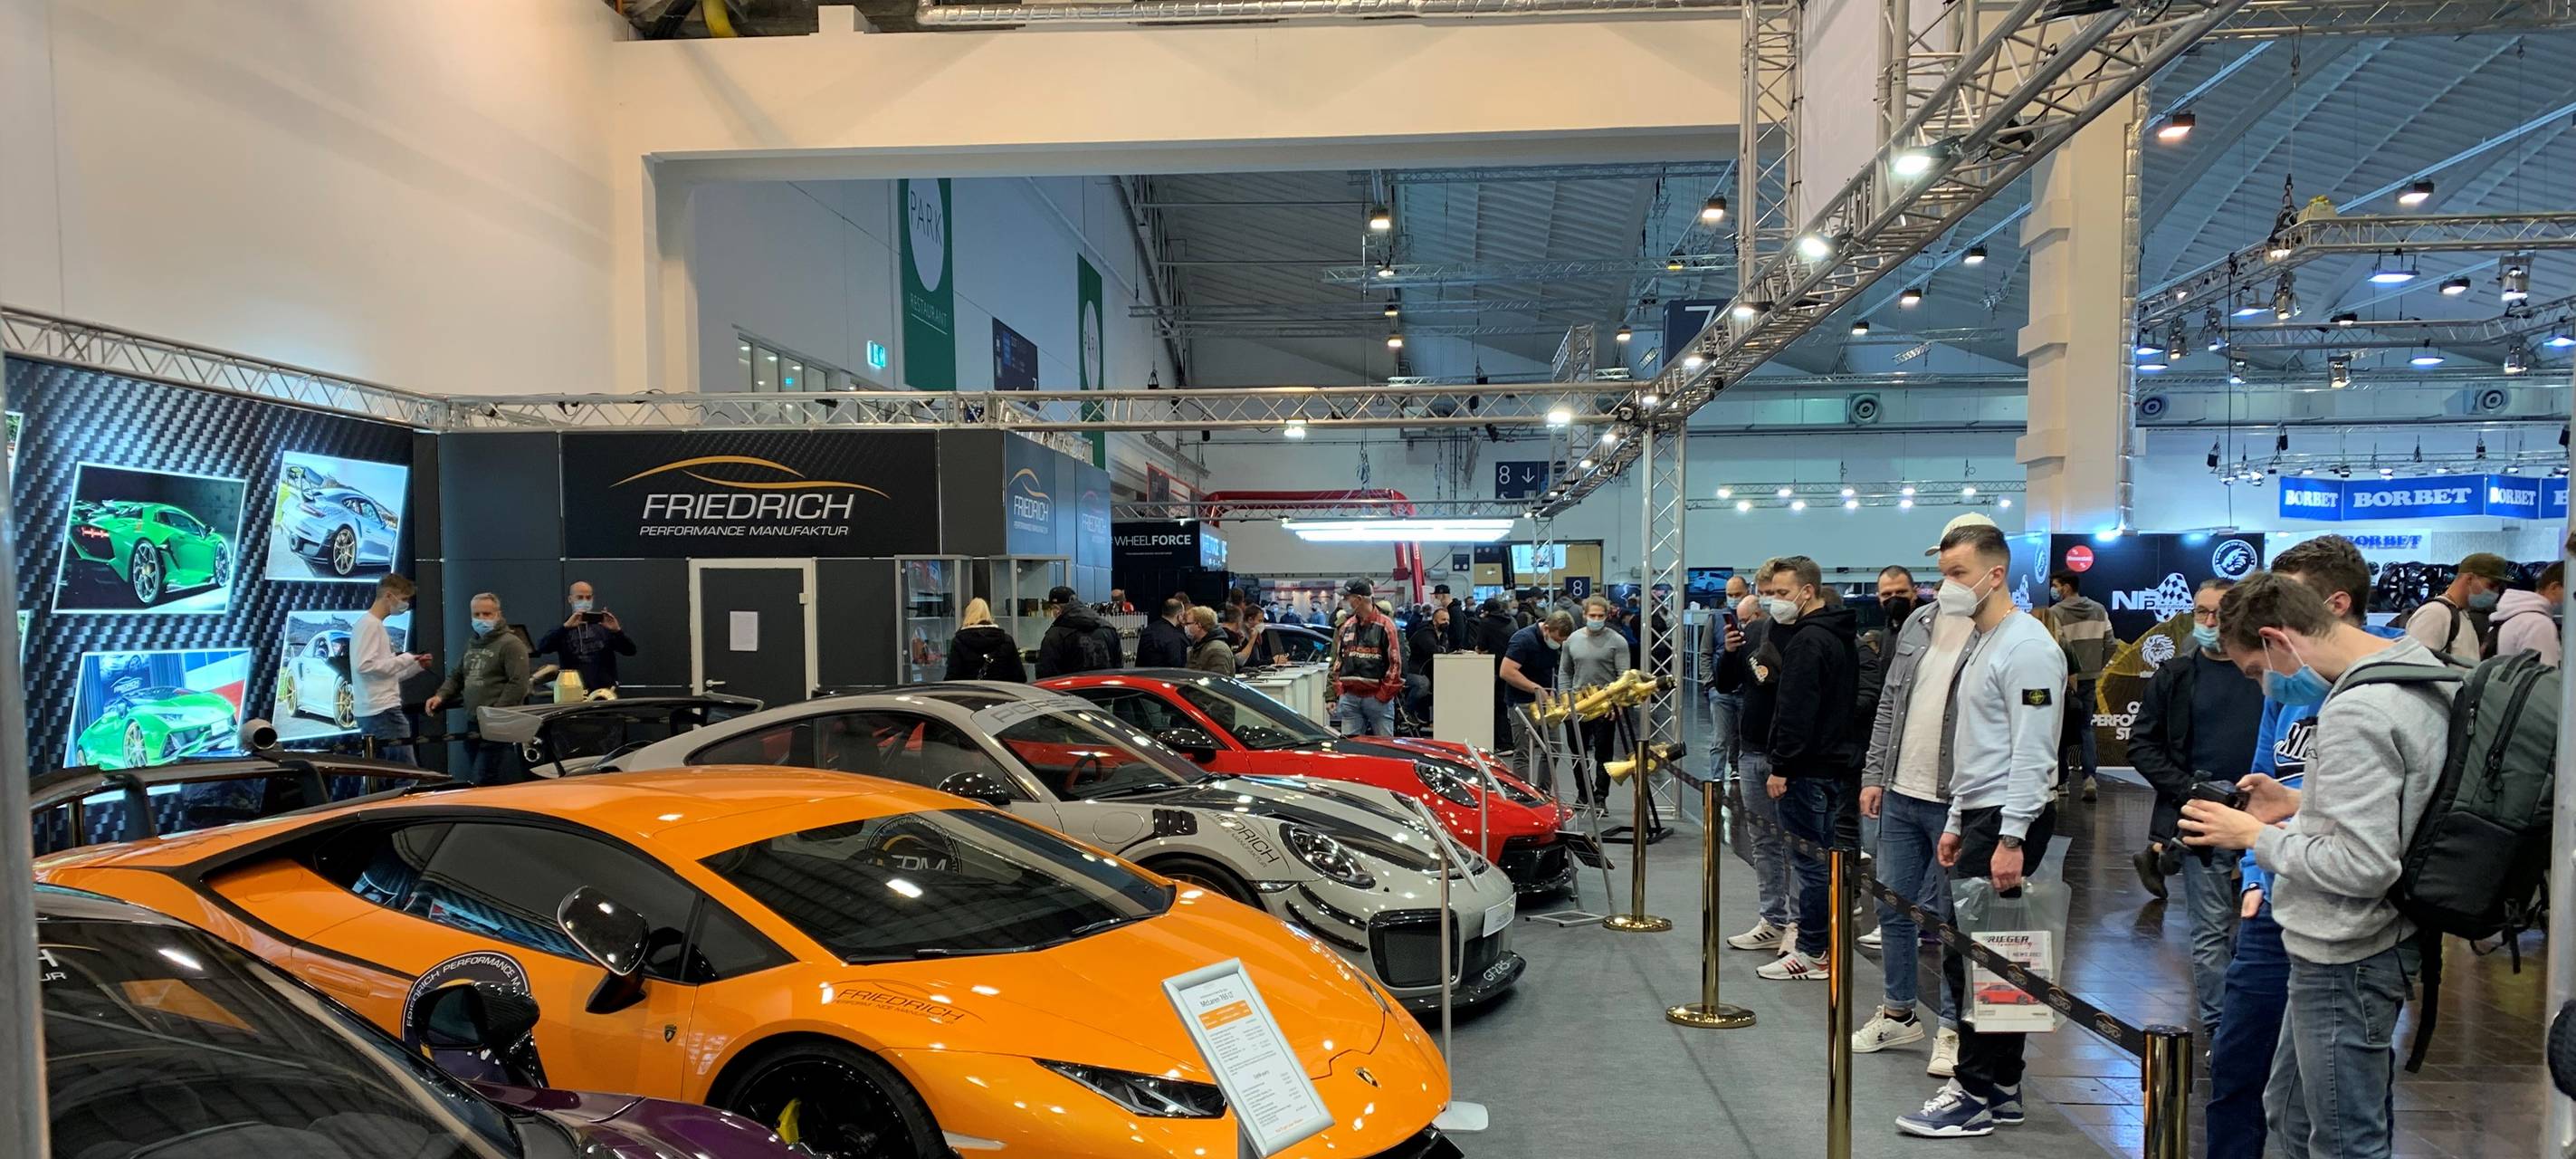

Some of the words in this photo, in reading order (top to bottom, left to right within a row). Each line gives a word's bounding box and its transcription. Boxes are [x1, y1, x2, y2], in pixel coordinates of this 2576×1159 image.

[910, 190, 943, 247] PARK
[910, 292, 949, 329] RESTAURANT
[1498, 465, 1511, 485] 8
[642, 493, 854, 520] FRIEDRICH
[2284, 489, 2339, 508] BORBET
[2353, 487, 2473, 508] BORBET
[2489, 486, 2537, 506] BORBET
[1014, 494, 1049, 522] FRIEDRICH
[639, 525, 746, 536] PERFORMANCE
[749, 525, 849, 536] MANUFAKTUR
[1571, 579, 1584, 597] 8
[1987, 935, 2030, 943] RIEGER
[406, 970, 440, 1028] FRIEDRICH
[443, 956, 515, 977] PERFORMANCE
[836, 989, 965, 1020] FRIEDRICH
